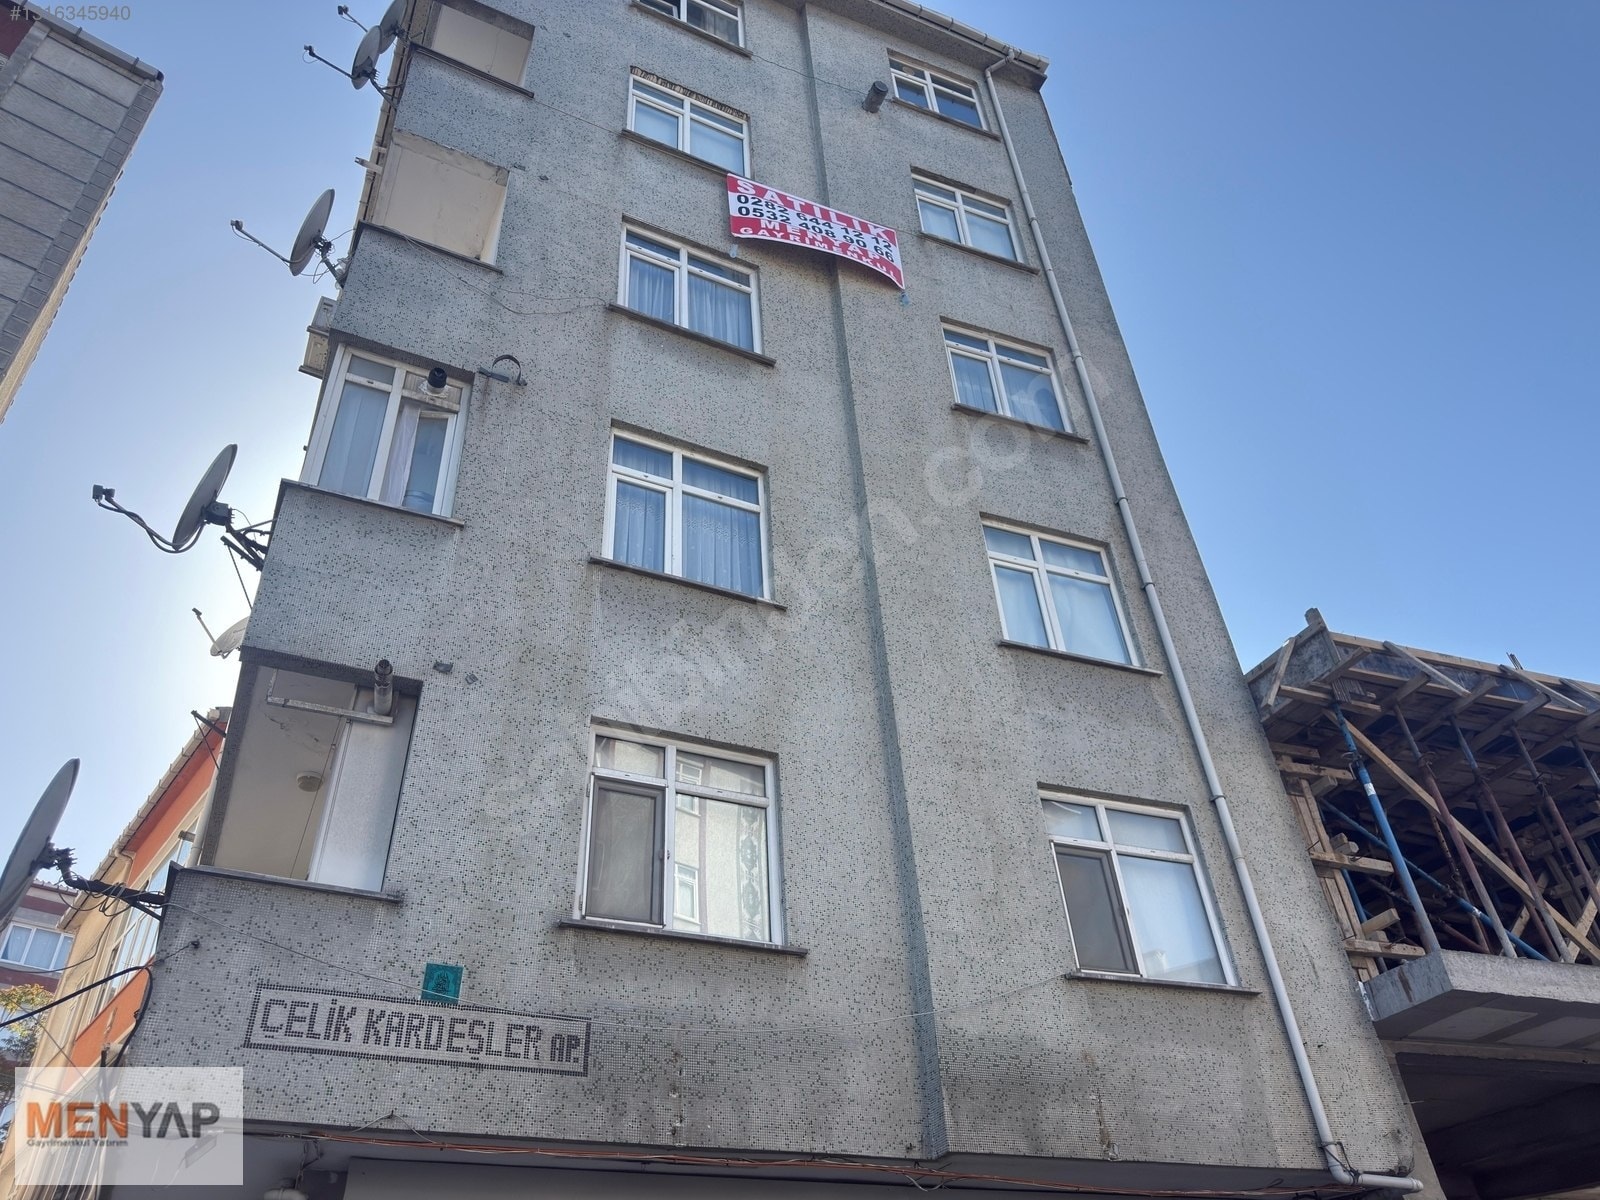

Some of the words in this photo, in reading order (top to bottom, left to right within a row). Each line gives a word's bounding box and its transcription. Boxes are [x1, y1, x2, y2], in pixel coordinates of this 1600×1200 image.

[737, 180, 889, 241] SATILIK
[737, 195, 790, 215] 0282
[796, 212, 834, 229] 644
[841, 227, 865, 240] 12
[871, 236, 893, 253] 12
[738, 206, 792, 225] 0532
[799, 222, 836, 239] 408
[843, 234, 867, 248] 90
[873, 245, 895, 263] 66
[760, 219, 880, 259] MENYAP
[260, 998, 357, 1043] ÇELİK
[363, 1008, 543, 1061] KARDEŞLER
